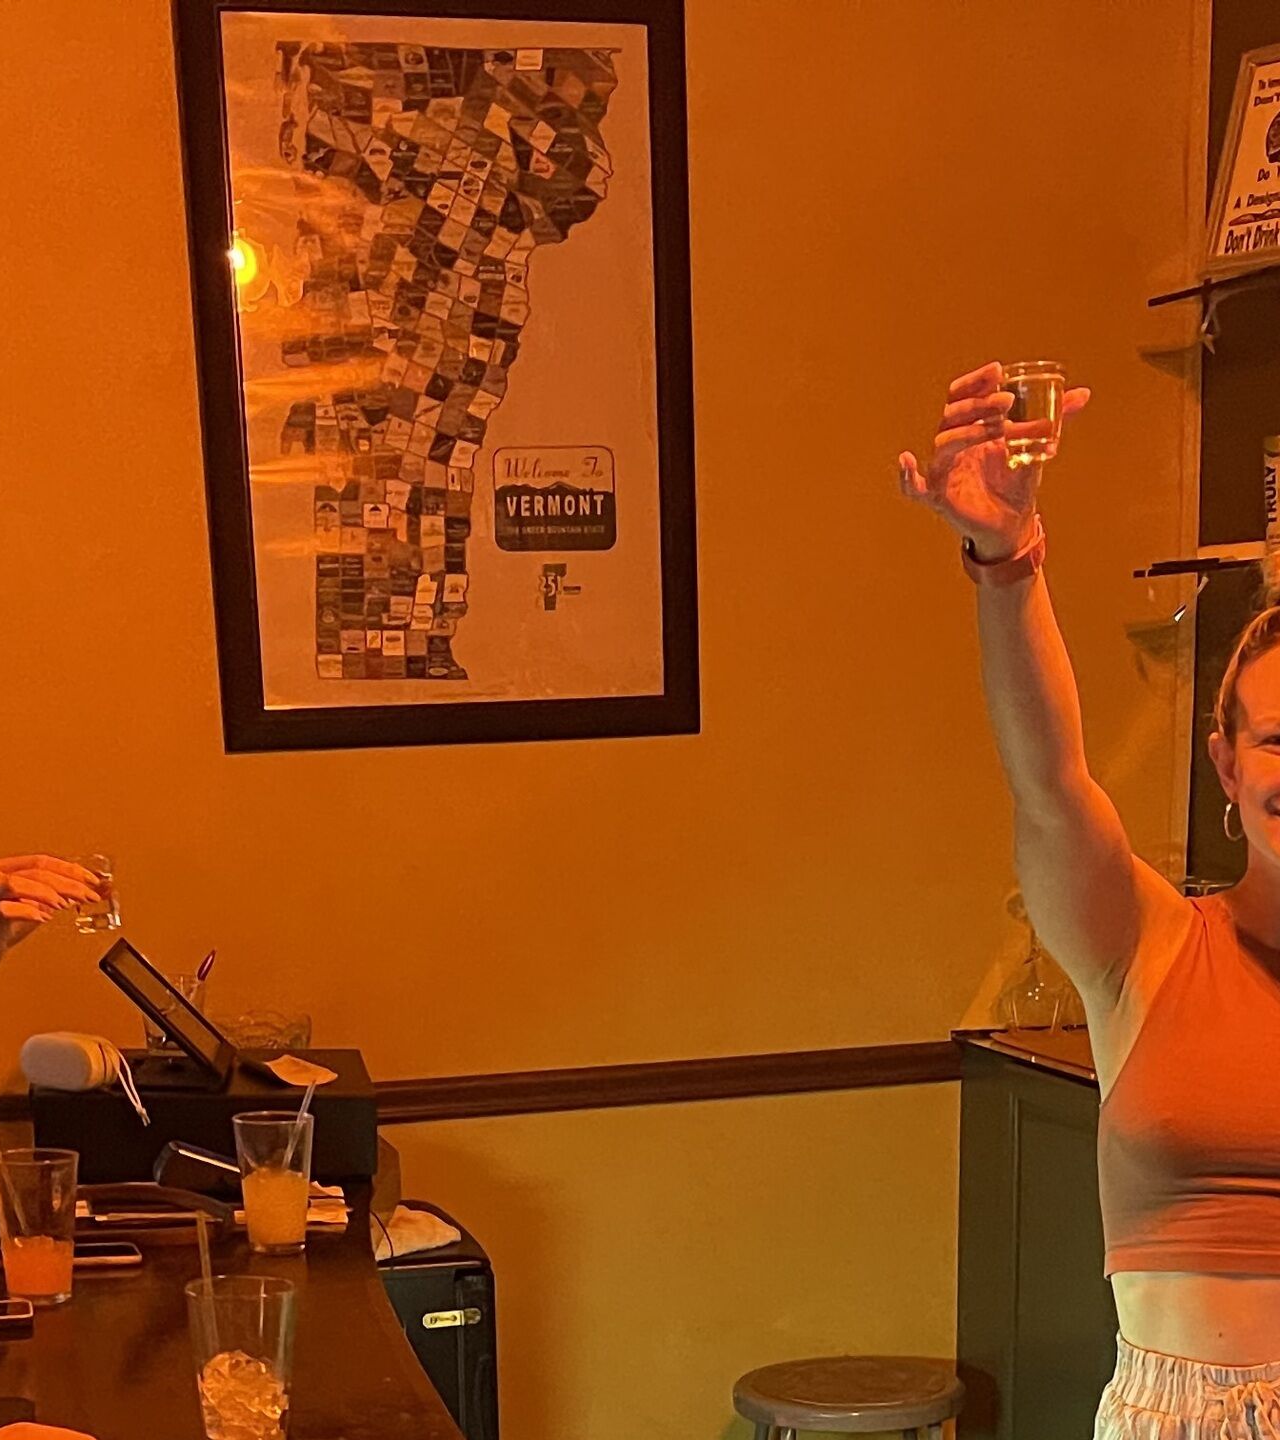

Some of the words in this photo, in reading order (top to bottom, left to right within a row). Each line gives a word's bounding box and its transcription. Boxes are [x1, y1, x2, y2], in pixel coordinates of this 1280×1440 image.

[1257, 168, 1270, 182] Do
[1233, 196, 1242, 209] A
[1224, 226, 1252, 254] Don't
[1253, 221, 1280, 250] Drink
[504, 457, 570, 479] Welcome
[581, 456, 604, 478] To
[1264, 465, 1278, 523] TRULY
[506, 494, 604, 518] VERMONT
